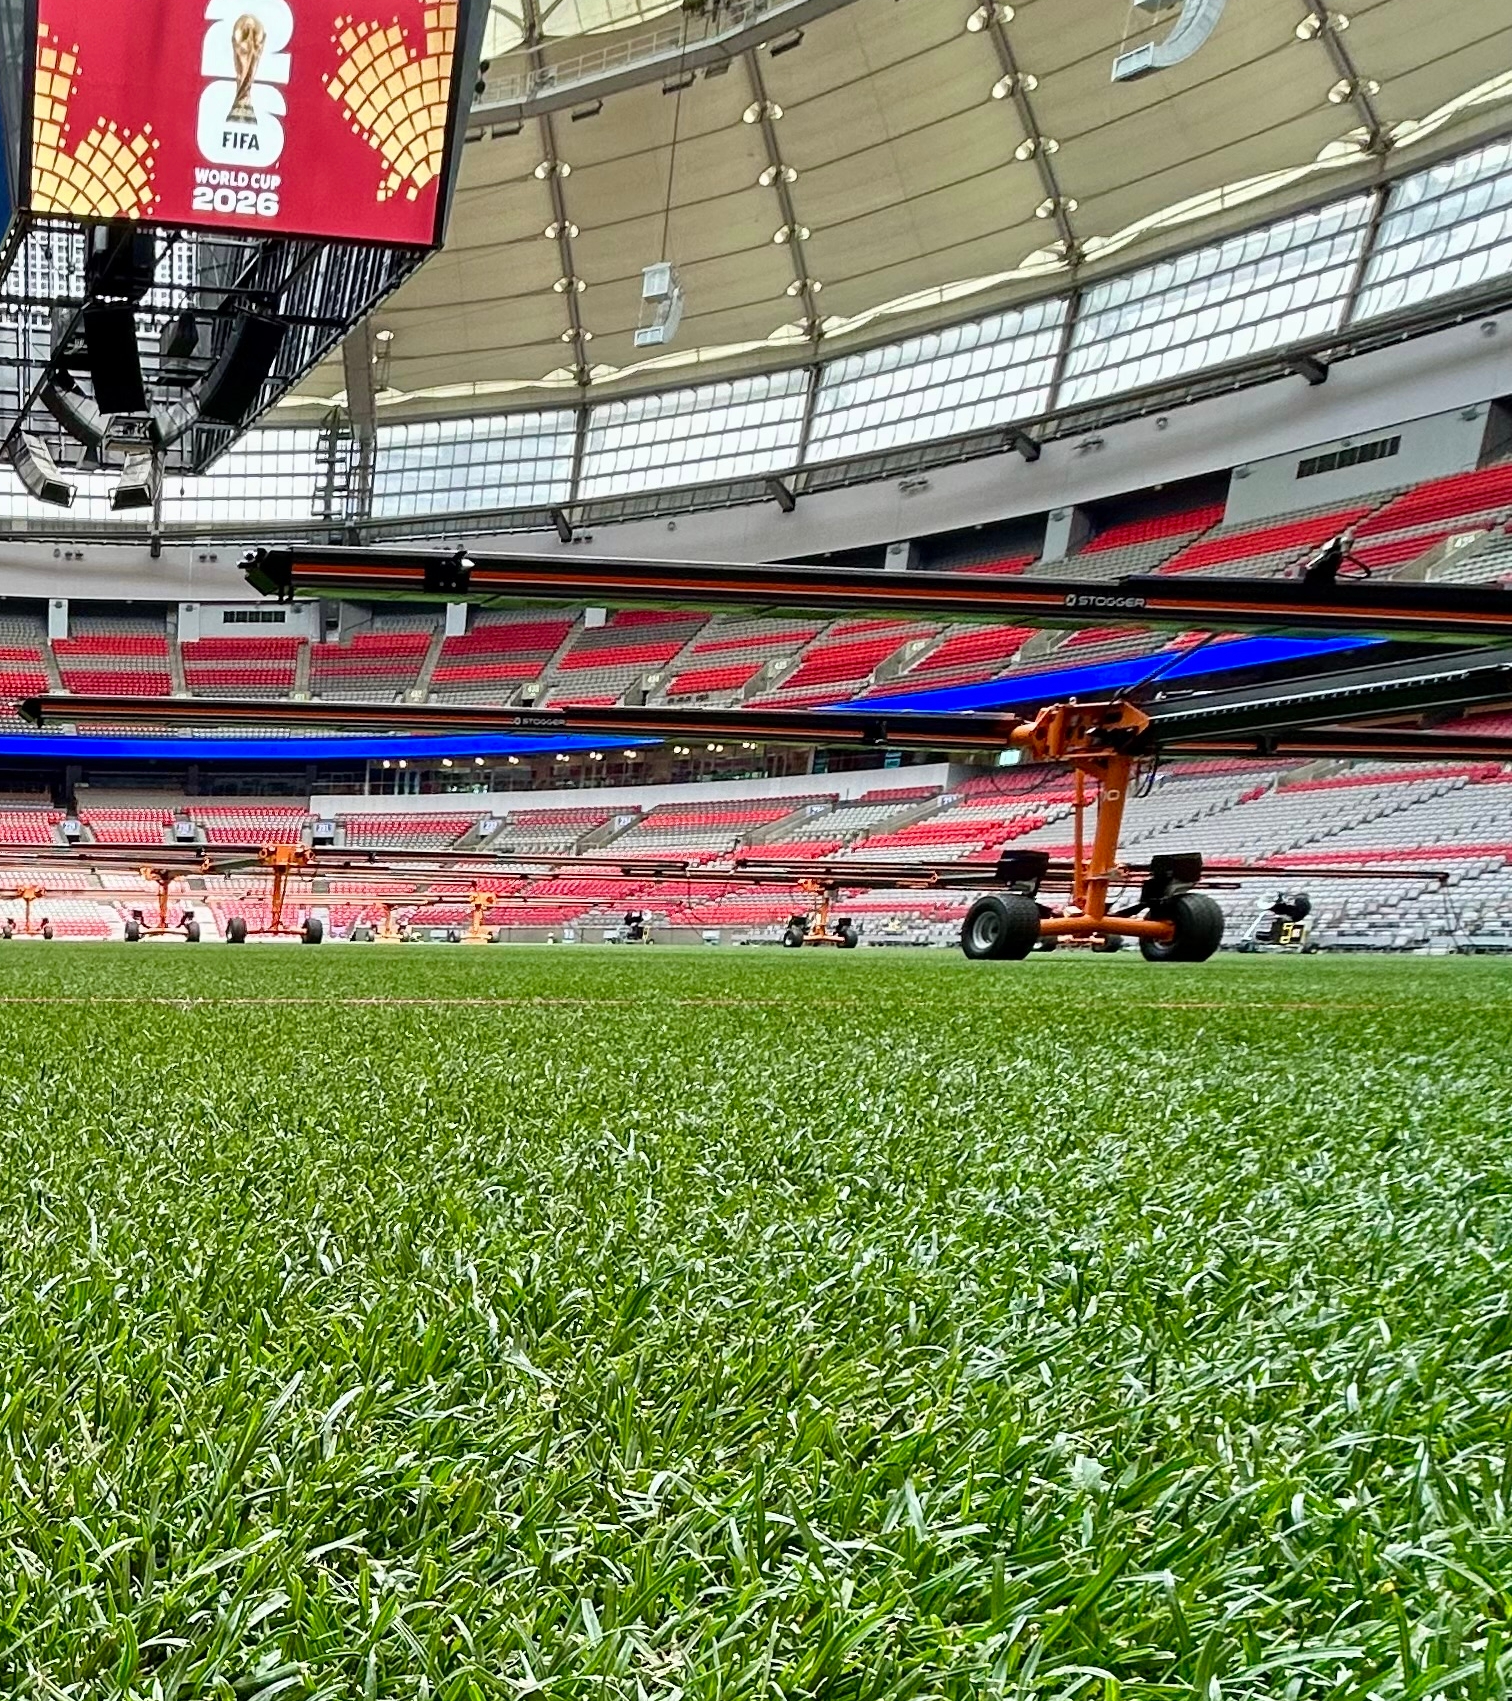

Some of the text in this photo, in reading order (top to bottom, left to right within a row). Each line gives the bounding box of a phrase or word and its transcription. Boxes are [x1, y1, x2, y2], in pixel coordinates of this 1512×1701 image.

[222, 131, 260, 151] FIFA
[194, 167, 282, 190] WORLD CUP
[192, 186, 279, 217] 2026
[1078, 595, 1146, 608] STOGGER
